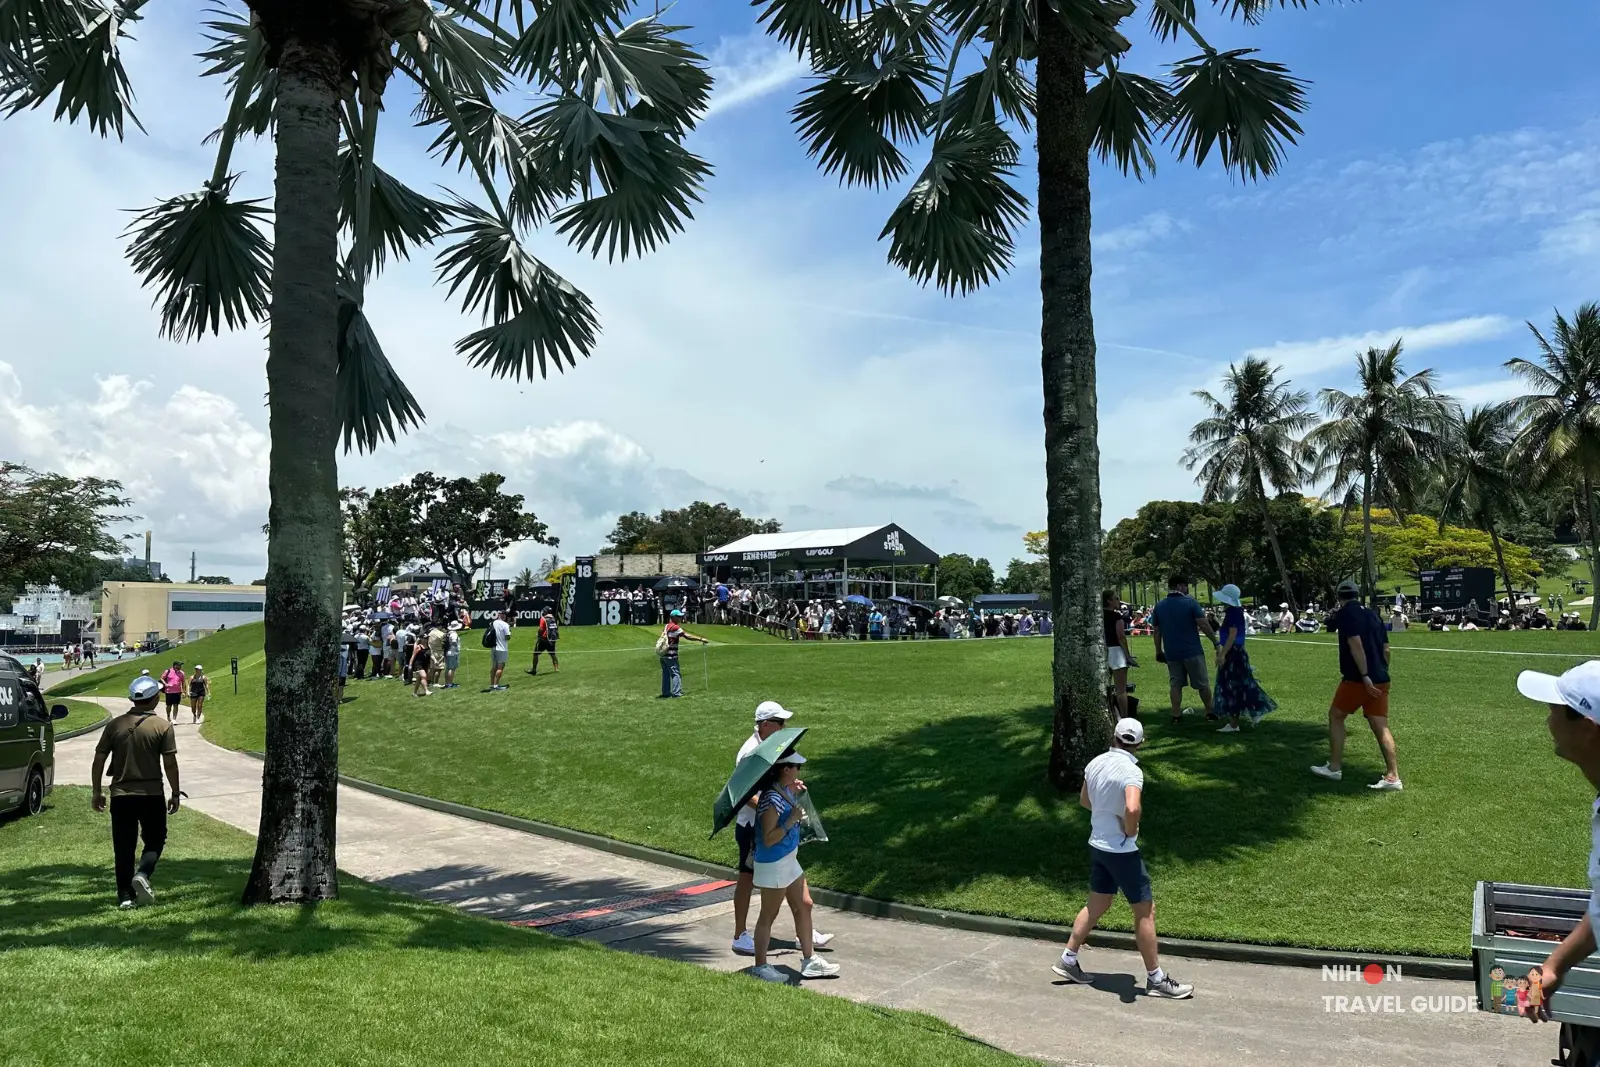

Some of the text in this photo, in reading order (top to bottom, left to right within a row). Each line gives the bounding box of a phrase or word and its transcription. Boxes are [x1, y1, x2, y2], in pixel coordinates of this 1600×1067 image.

[576, 565, 592, 578] 18
[568, 576, 576, 604] GOLF
[599, 600, 621, 625] 18
